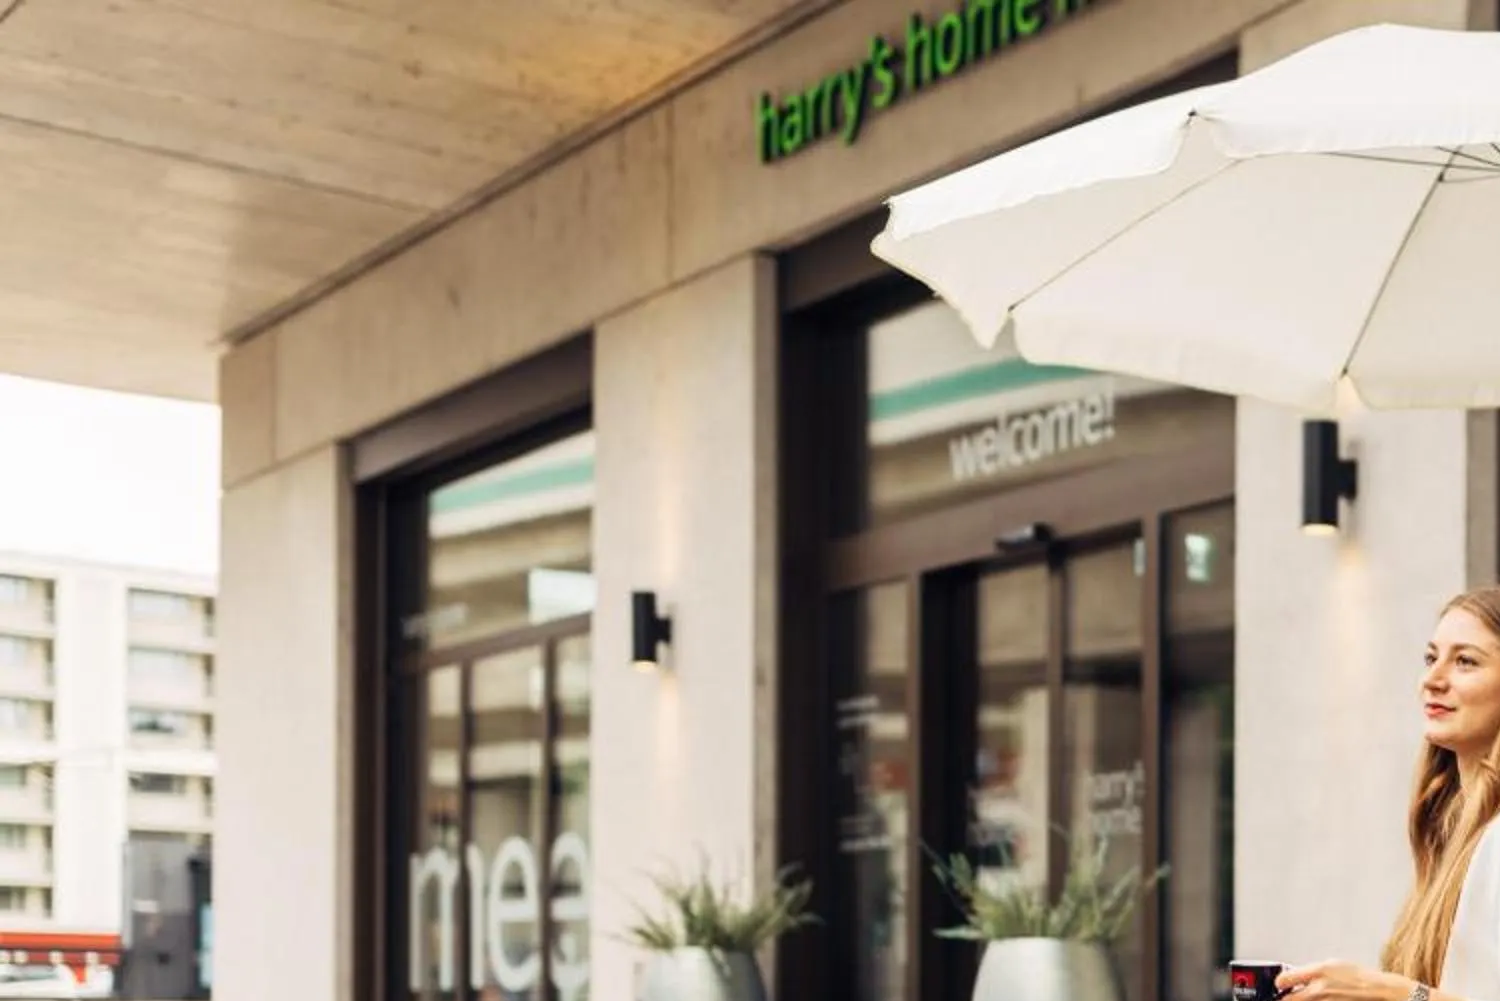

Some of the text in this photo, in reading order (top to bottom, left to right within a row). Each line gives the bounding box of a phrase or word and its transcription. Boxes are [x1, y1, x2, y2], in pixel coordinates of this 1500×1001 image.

[755, 0, 1042, 164] harry's home
[949, 374, 1115, 481] welcome!
